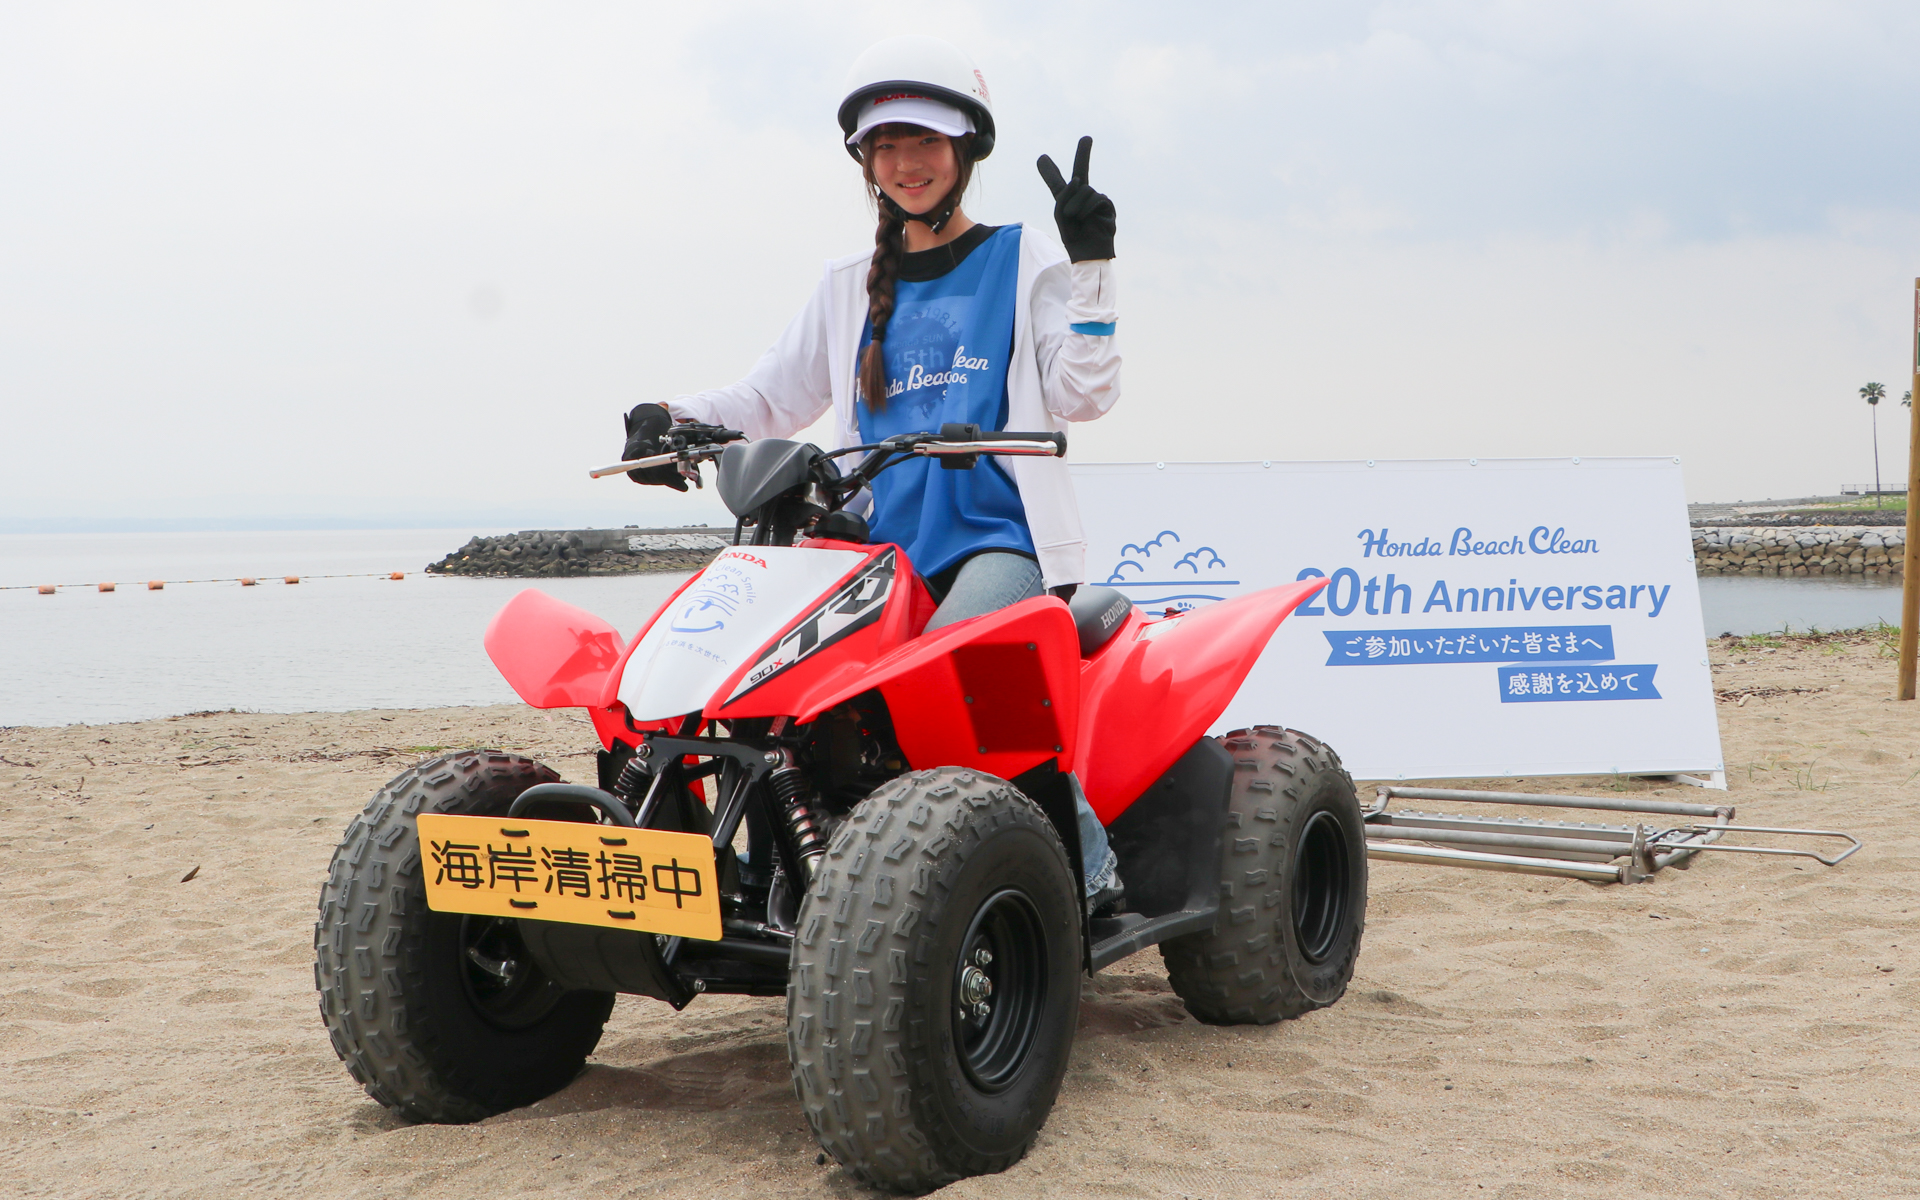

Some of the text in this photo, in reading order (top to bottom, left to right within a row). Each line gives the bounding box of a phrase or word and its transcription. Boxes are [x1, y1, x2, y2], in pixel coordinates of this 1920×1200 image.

[891, 346, 944, 373] 45th
[906, 364, 952, 392] Beac
[951, 345, 989, 371] lean
[1357, 525, 1600, 558] Honda Beach Clean
[716, 552, 768, 570] ONDA
[715, 563, 757, 605] Clean Smile
[1294, 567, 1671, 617] 20th Anniversary
[1100, 597, 1129, 630] HONDA
[1344, 631, 1604, 659] ご参加いただいた皆さまへ
[750, 657, 784, 685] 90X
[1507, 672, 1640, 696] 感謝を込めて
[430, 840, 702, 909] 海岸清掃中
